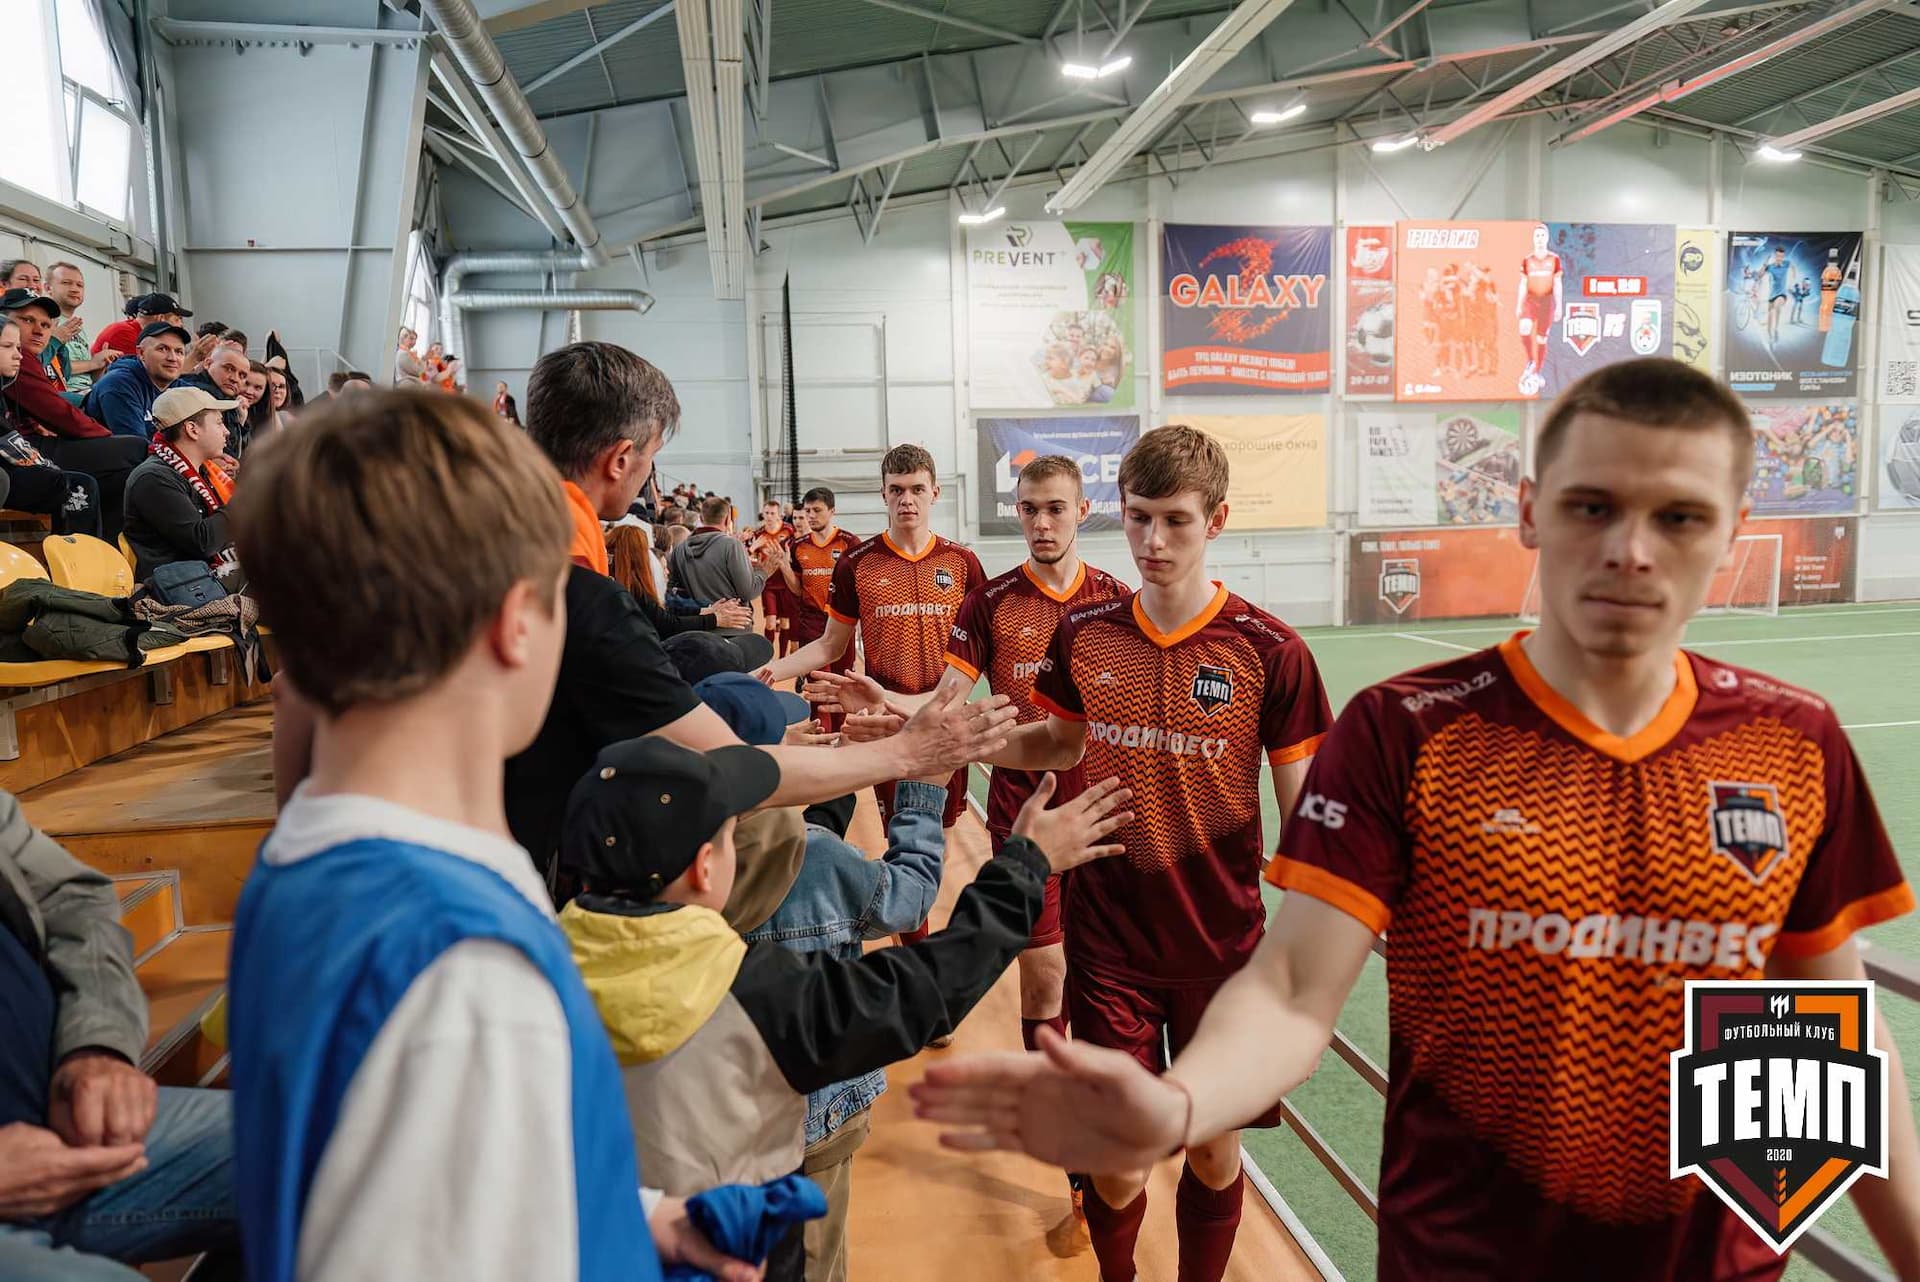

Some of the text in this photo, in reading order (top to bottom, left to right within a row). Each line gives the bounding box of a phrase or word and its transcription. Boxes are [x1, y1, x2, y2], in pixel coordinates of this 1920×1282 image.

[973, 249, 1056, 267] PREVENT
[1169, 273, 1326, 309] GALAXY
[1730, 371, 1793, 381] ИЗОТОНИК
[875, 603, 952, 618] ПРОДИНВЕСТ
[1196, 679, 1230, 701] ТЕМП
[1088, 721, 1228, 758] ПРОДИНВЕСТ
[1716, 807, 1783, 849] ТЕМП
[1467, 908, 1779, 969] ПРОДИНВЕС
